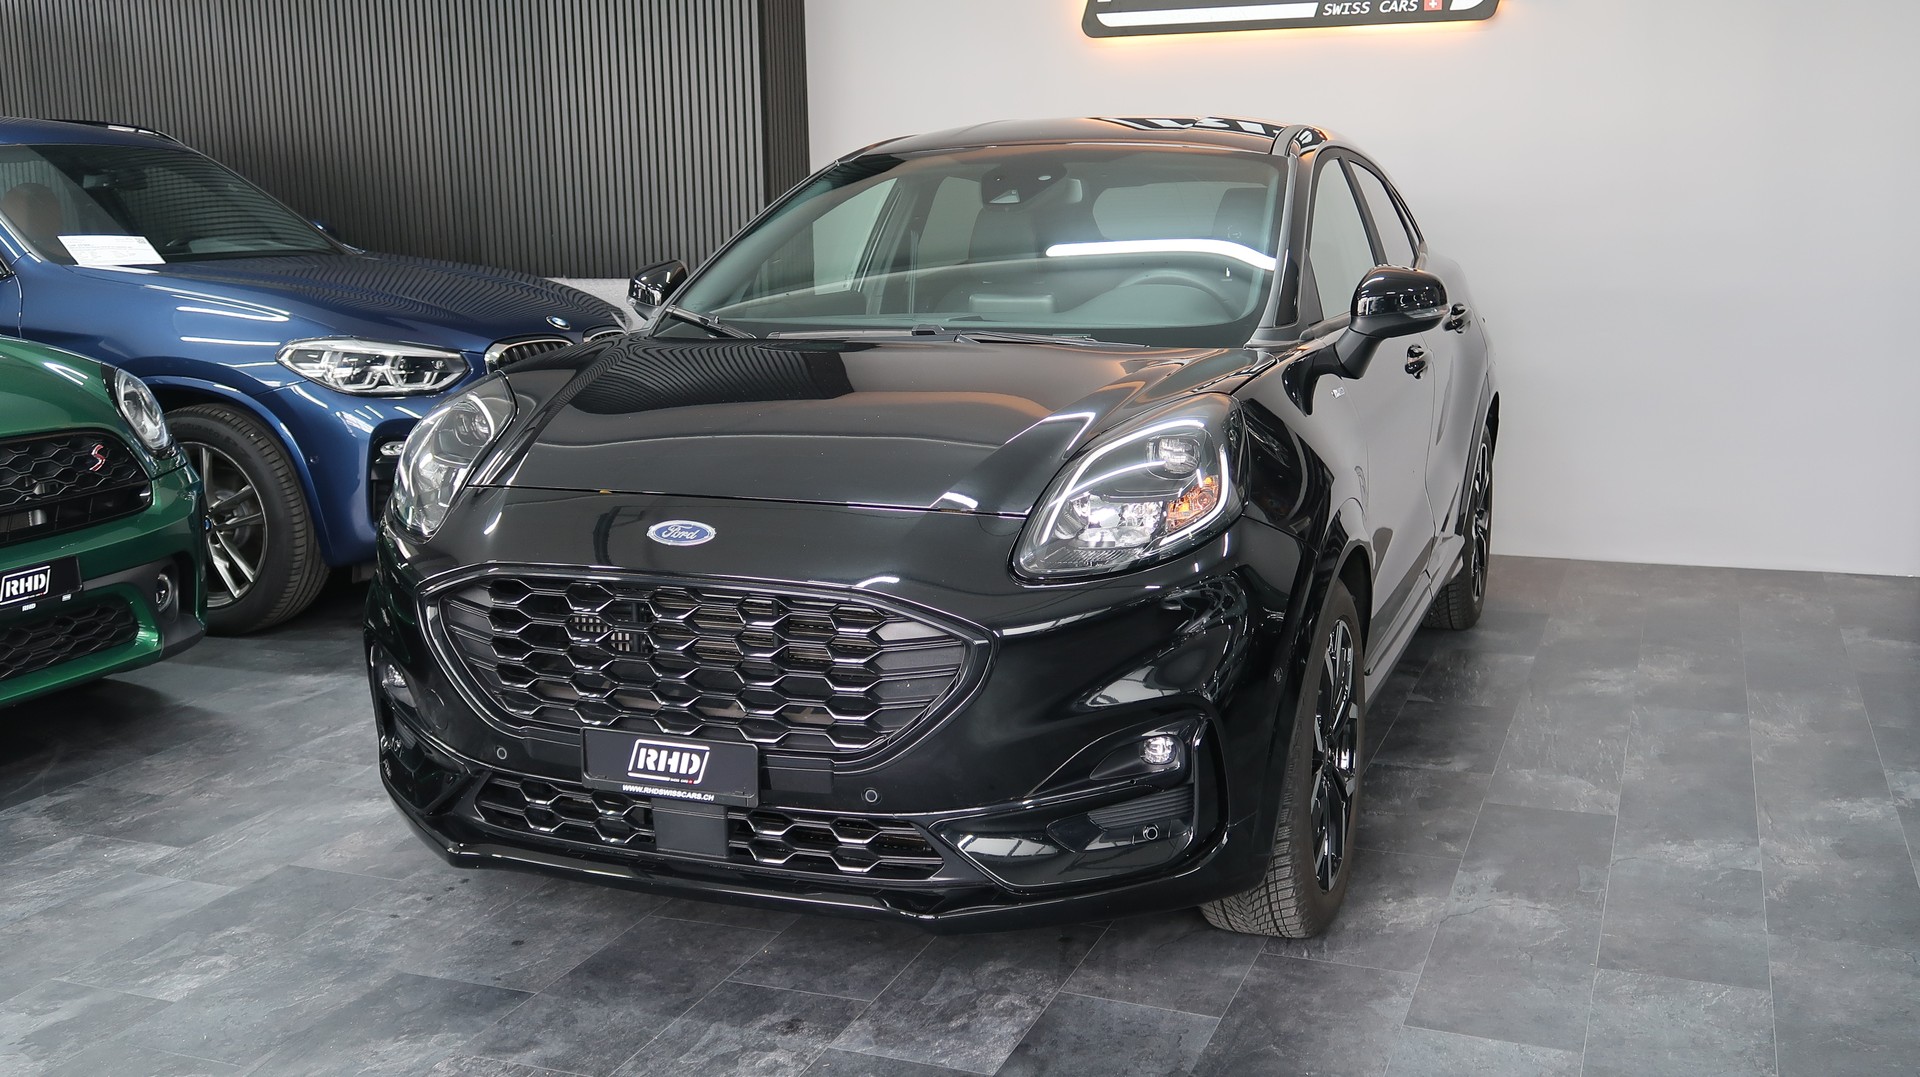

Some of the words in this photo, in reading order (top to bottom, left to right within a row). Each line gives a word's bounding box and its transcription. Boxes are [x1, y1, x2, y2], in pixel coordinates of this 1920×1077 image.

[1322, 2, 1371, 16] SWISS
[1379, 0, 1418, 13] CARS
[661, 524, 700, 540] Ford
[5, 573, 46, 598] RHD
[637, 748, 701, 775] RHD
[622, 784, 715, 802] WWW.RHDSWISSCARS.CH
